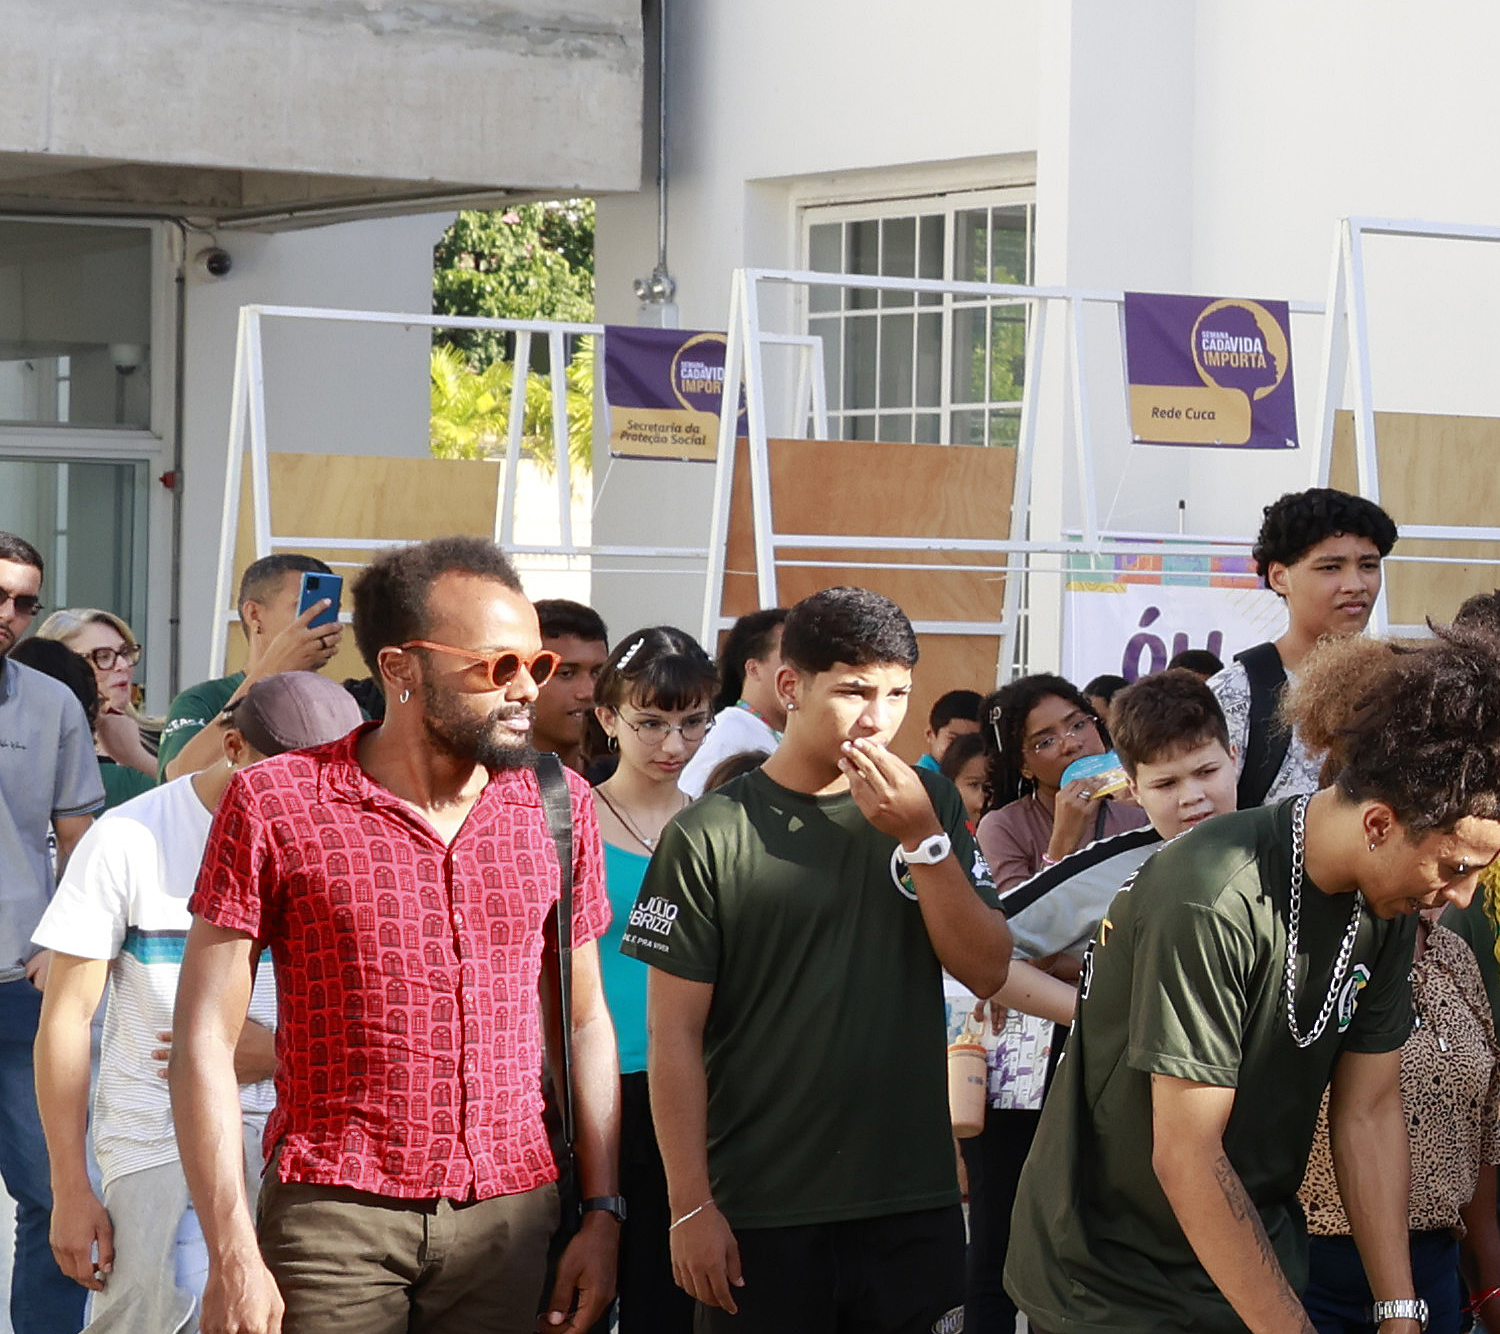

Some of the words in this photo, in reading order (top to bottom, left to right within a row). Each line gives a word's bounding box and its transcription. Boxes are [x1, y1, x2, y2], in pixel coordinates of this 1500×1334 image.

[1201, 330, 1229, 339] SEMANA
[1202, 338, 1231, 351] CADA
[1228, 336, 1264, 354] VIDA
[1203, 352, 1268, 369] IMPORTA
[703, 367, 725, 381] VID
[681, 379, 723, 394] IMPOR
[1151, 406, 1182, 420] Rede
[1185, 408, 1216, 421] Cuca
[627, 419, 681, 434] Secretaria
[684, 423, 700, 434] da
[620, 430, 667, 445] Proteção
[671, 434, 707, 445] Social
[630, 910, 673, 936] BRIZZI
